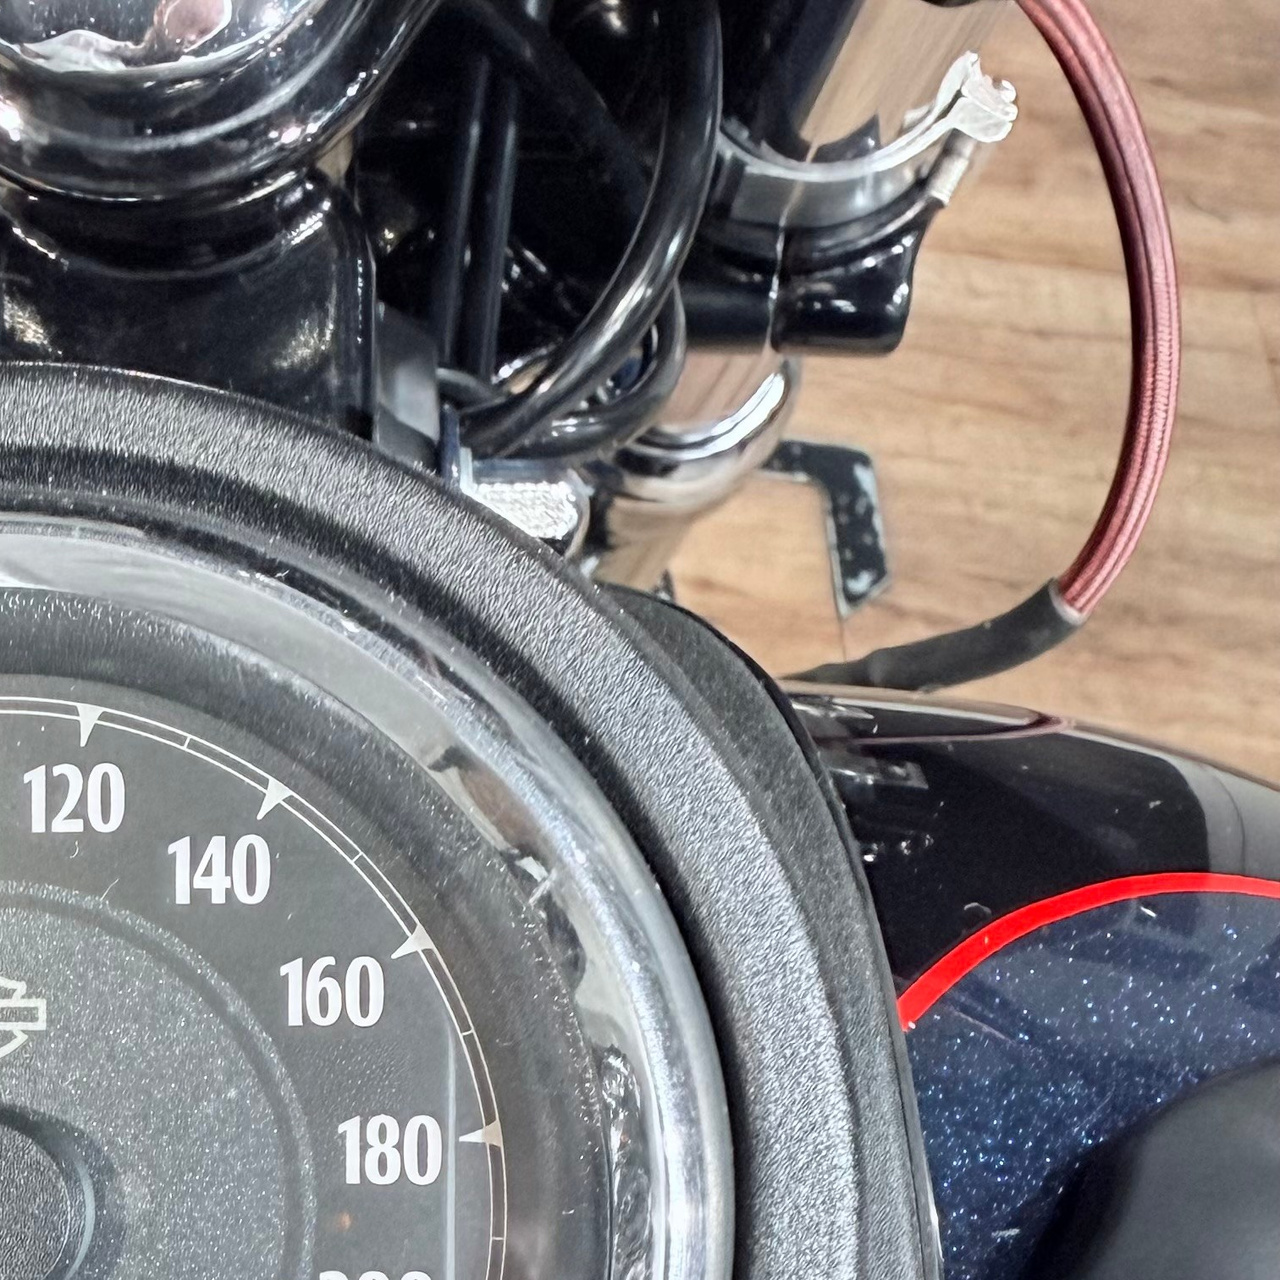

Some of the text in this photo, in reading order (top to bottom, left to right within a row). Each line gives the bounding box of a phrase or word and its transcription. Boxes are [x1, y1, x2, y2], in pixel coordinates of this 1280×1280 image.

[23, 762, 126, 834] 120
[167, 833, 271, 905] 140
[279, 955, 385, 1028] 160
[337, 1114, 443, 1185] 180
